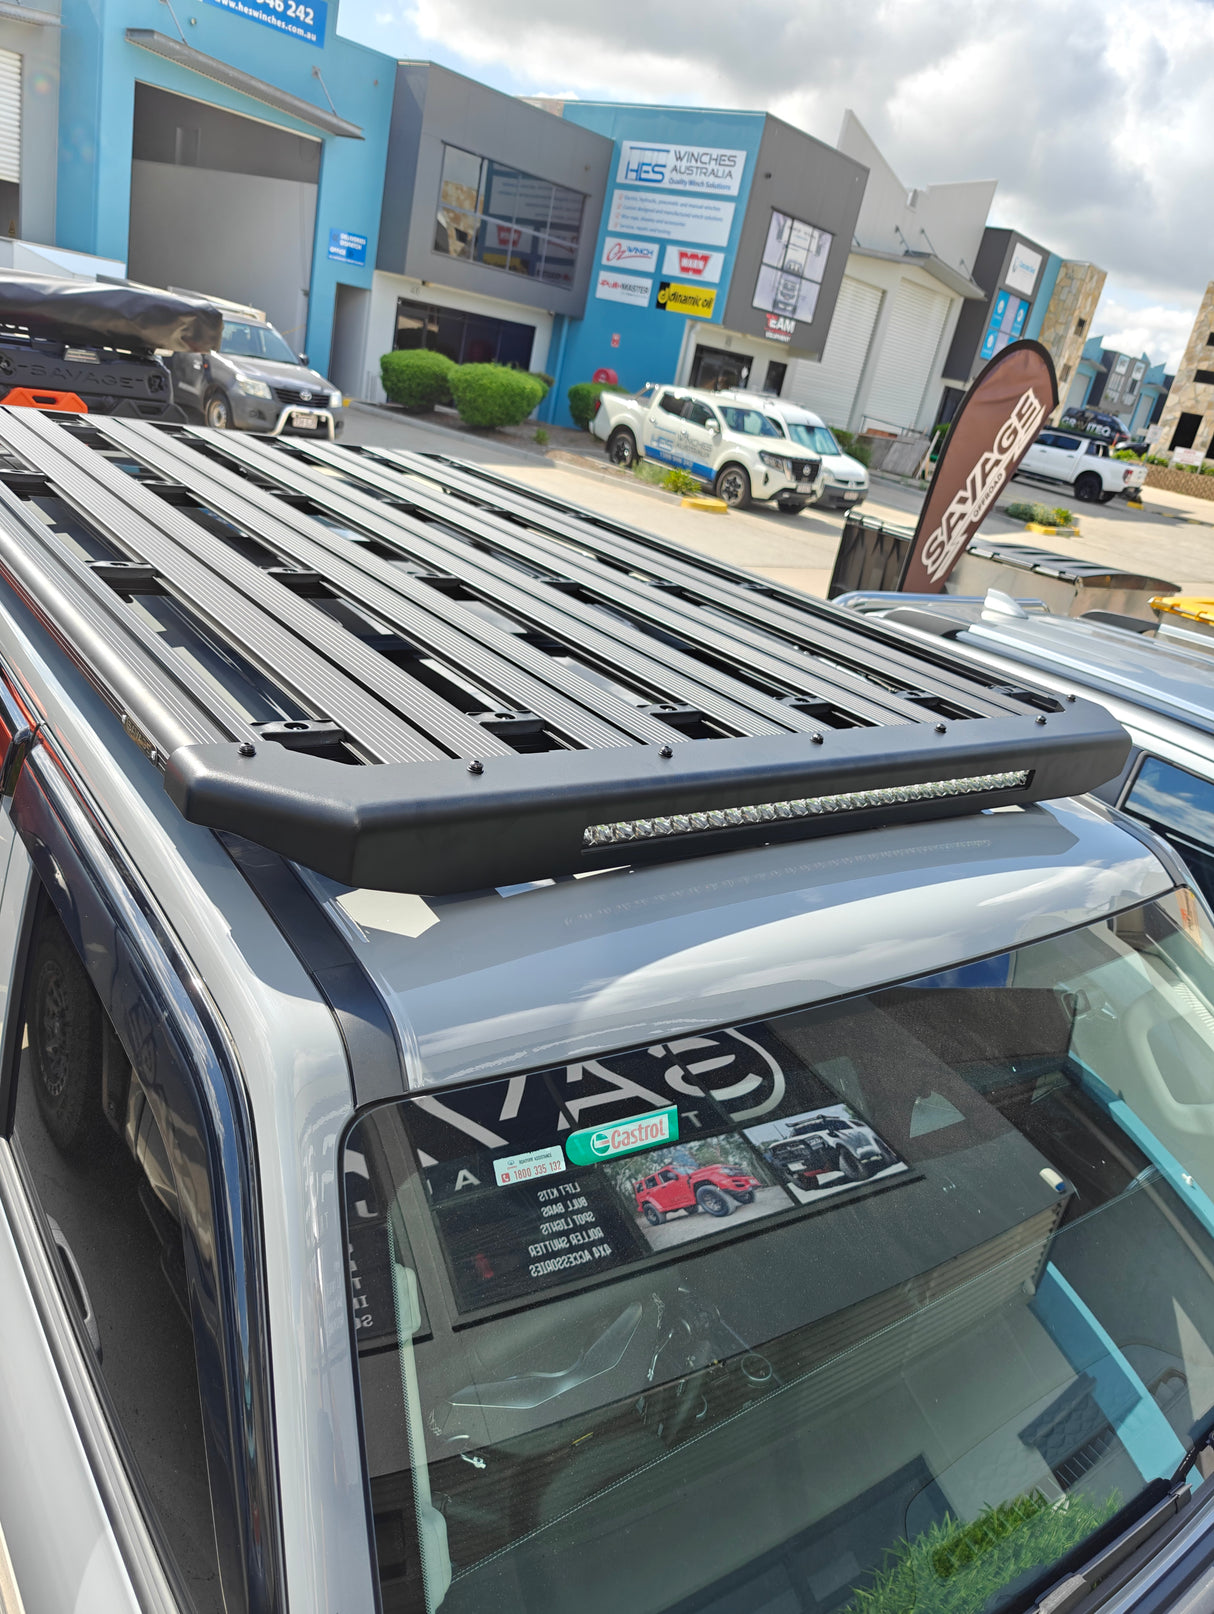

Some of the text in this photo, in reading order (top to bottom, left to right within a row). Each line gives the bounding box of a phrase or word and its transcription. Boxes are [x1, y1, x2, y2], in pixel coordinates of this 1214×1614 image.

[255, 0, 315, 26] 46 242
[673, 149, 738, 168] WINCHES
[625, 160, 667, 183] HES
[670, 164, 734, 180] AUSTRALIA
[705, 181, 732, 191] Solutions
[701, 297, 714, 309] oil
[766, 312, 796, 334] TEAM
[921, 388, 1042, 576] SAVAGE
[973, 472, 1004, 518] OFFROAD
[611, 1118, 666, 1149] Castrol
[513, 1160, 562, 1181] 1800 335 132
